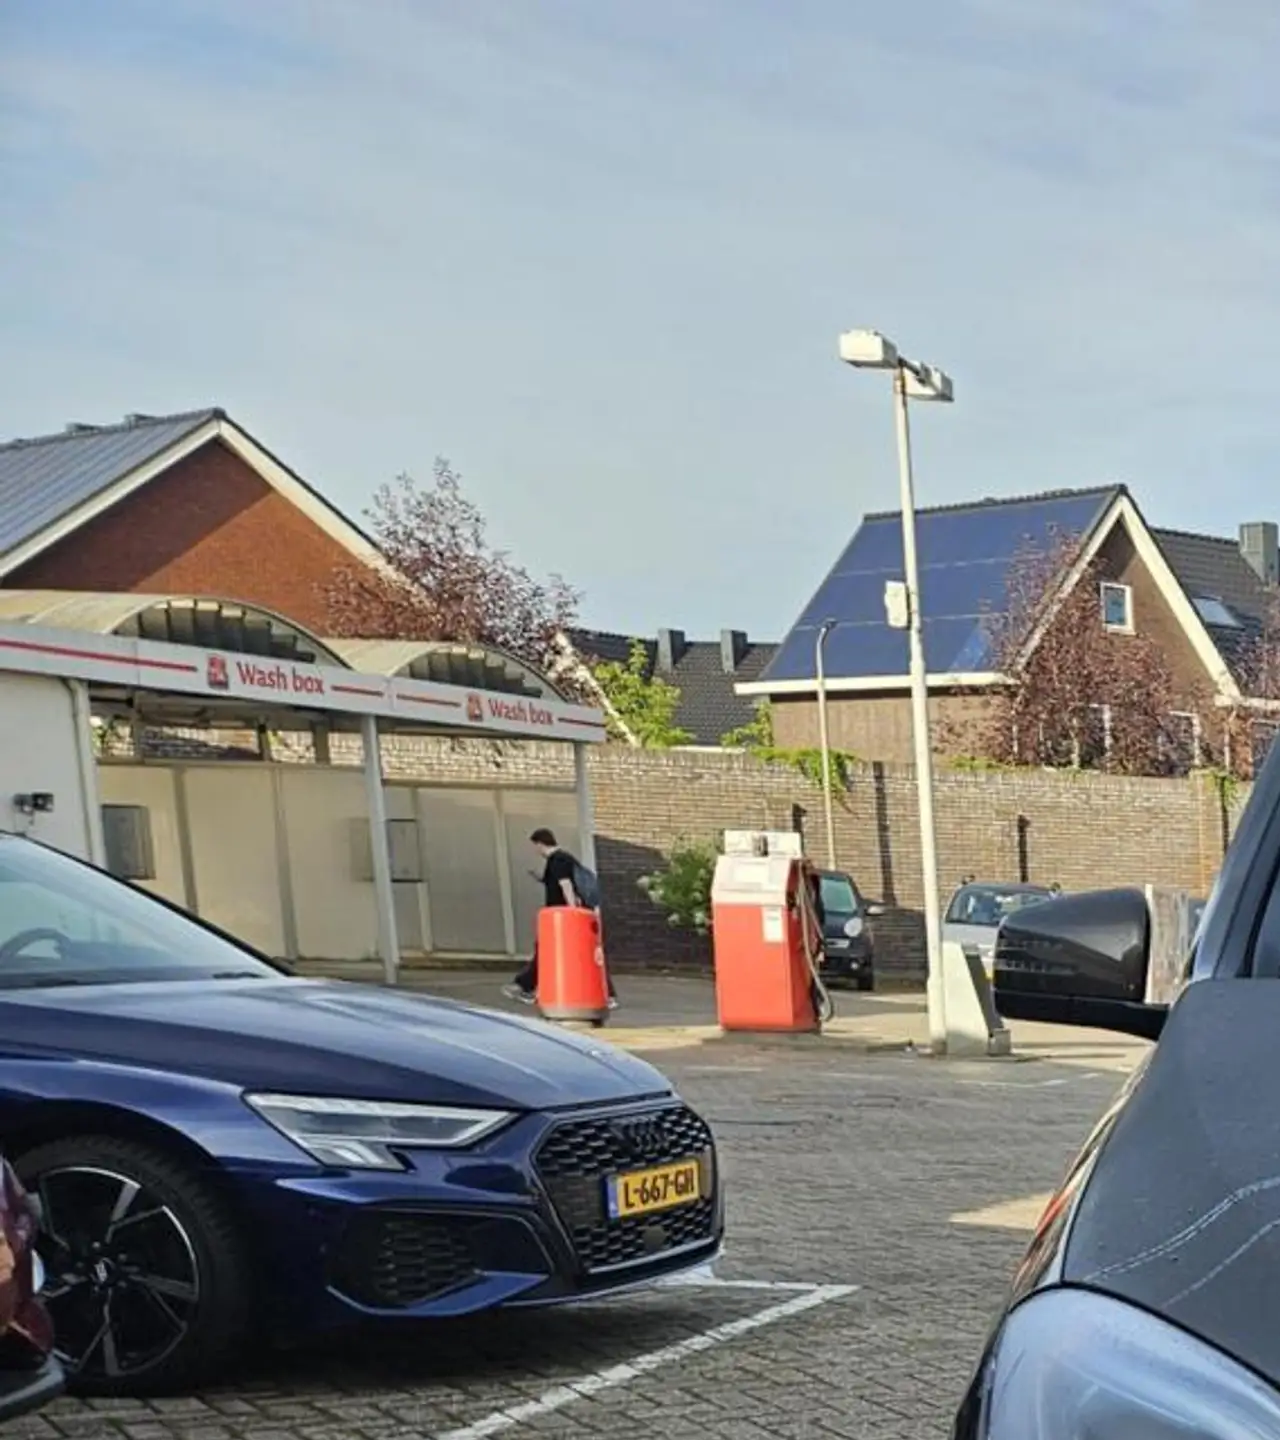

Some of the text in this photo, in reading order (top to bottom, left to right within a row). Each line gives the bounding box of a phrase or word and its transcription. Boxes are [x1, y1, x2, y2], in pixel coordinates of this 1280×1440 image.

[236, 661, 325, 694] Wash box
[488, 698, 554, 725] Wash box
